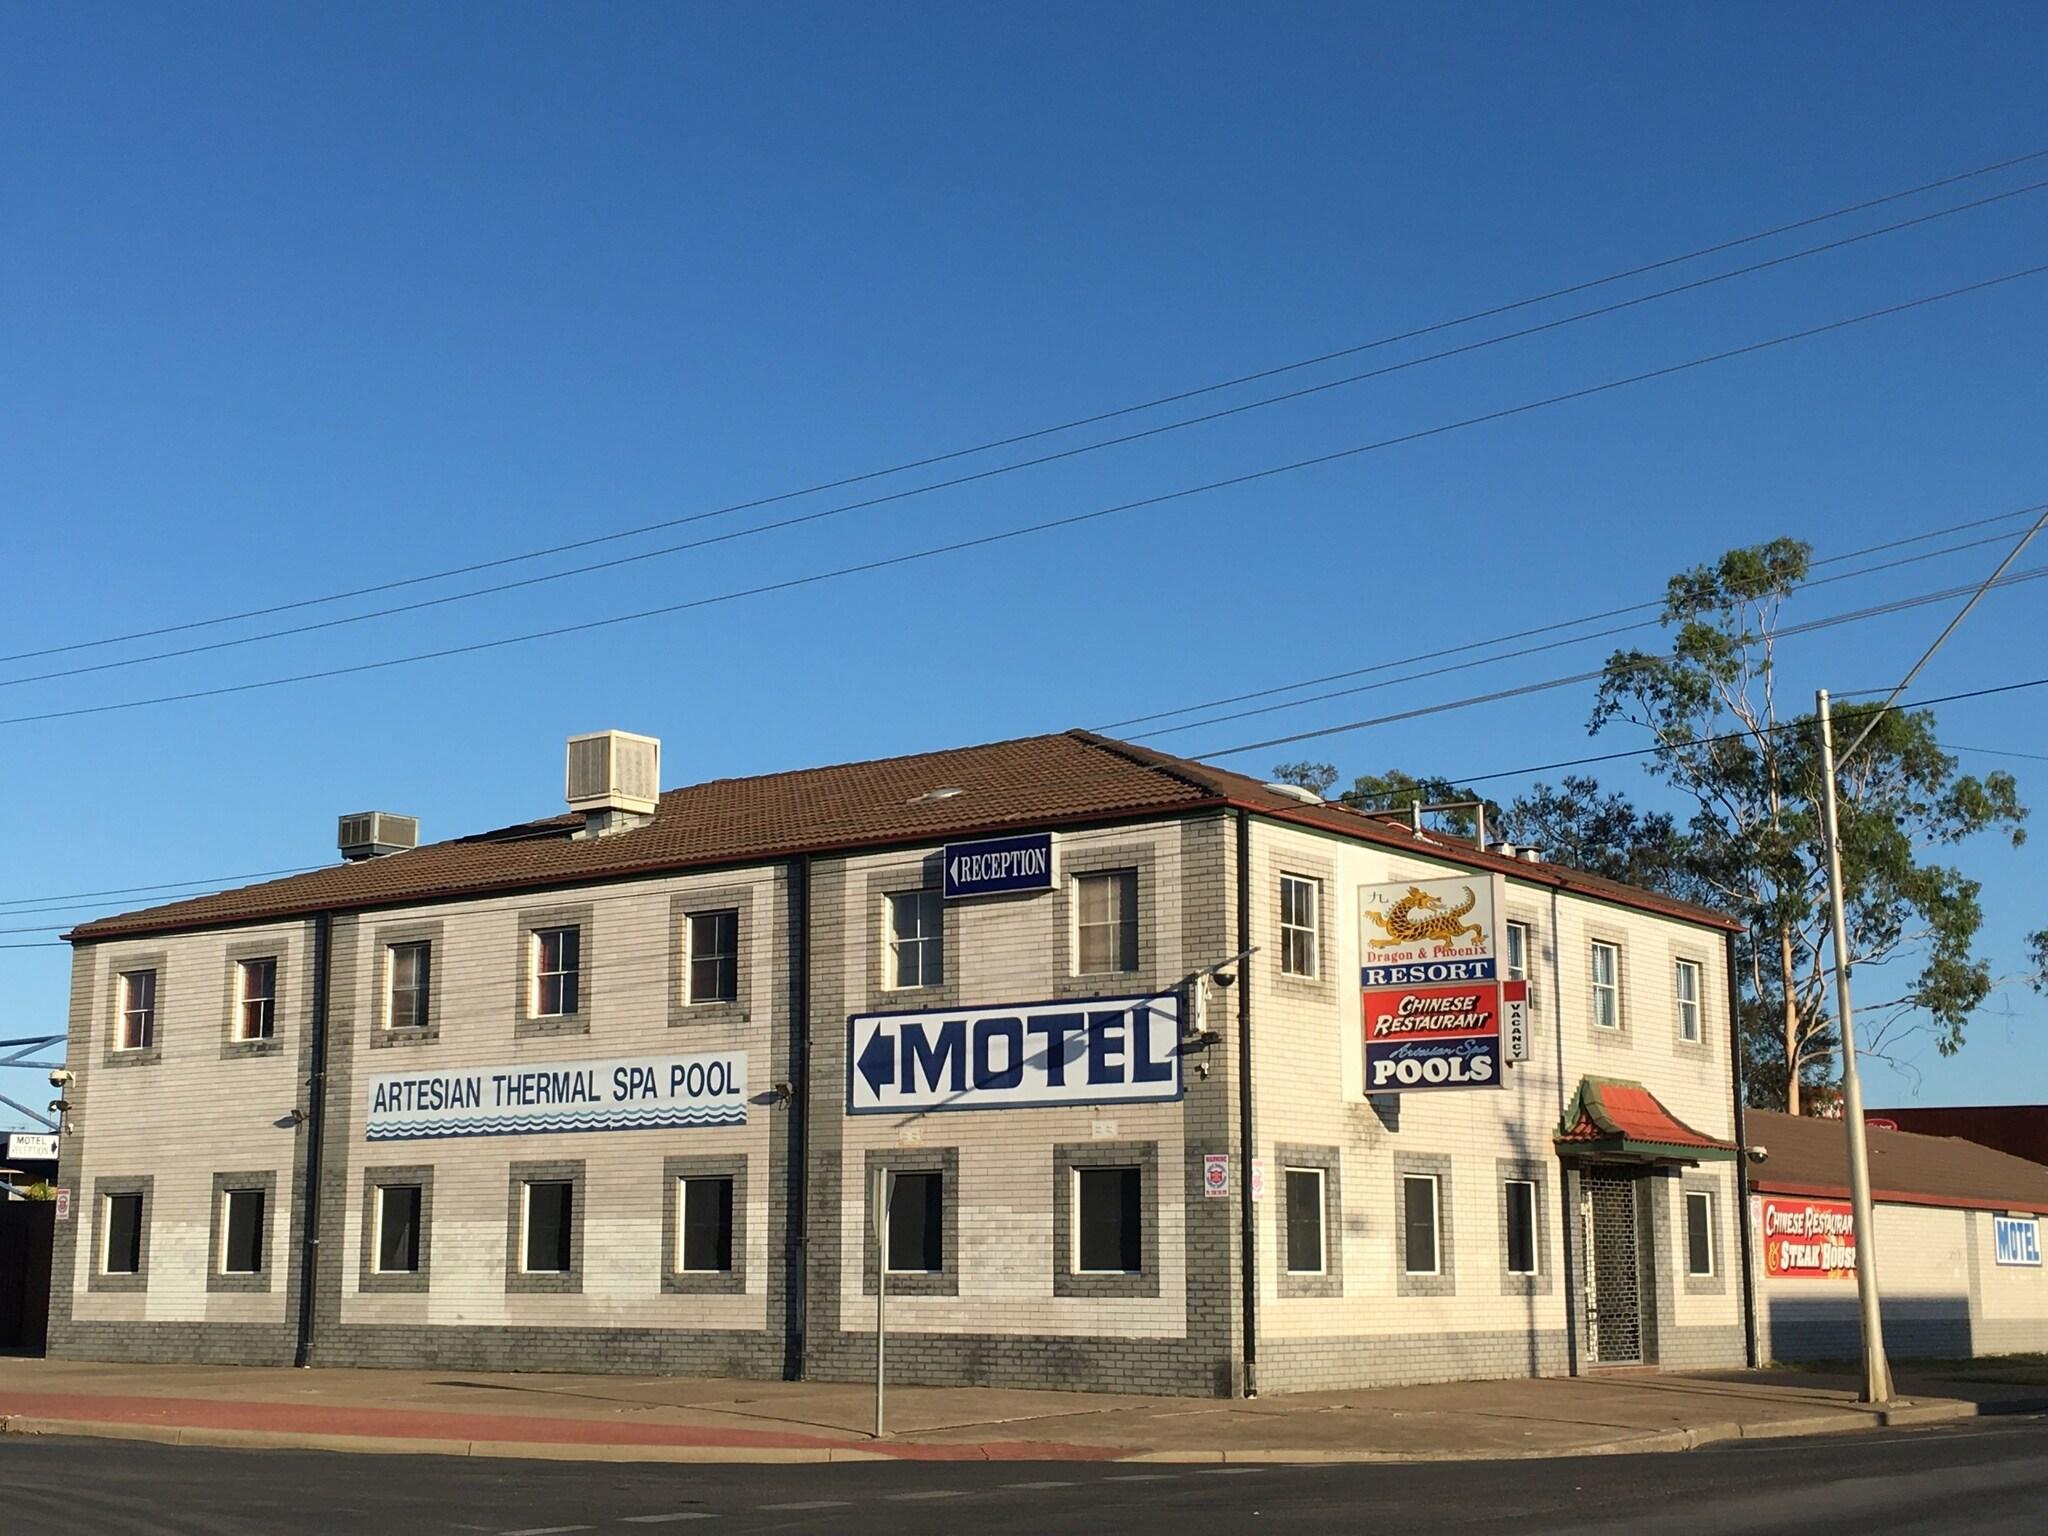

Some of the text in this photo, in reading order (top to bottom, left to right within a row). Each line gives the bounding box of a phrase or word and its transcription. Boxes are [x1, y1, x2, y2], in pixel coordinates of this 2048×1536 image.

[960, 847, 1047, 882] RECEPTION
[1367, 944, 1487, 963] Dragon & Phoenix
[1366, 961, 1488, 985] RESORT
[1397, 994, 1477, 1016] CHINESE
[1373, 1013, 1489, 1036] RESTAURANT
[1511, 1003, 1522, 1058] VACANCY
[900, 1007, 1173, 1094] MOTEL
[1389, 1039, 1490, 1060] Artesian Spa
[1373, 1055, 1493, 1085] POOLS
[373, 1061, 740, 1113] ARTESIAN THERMAL SPA POOL
[16, 1136, 47, 1145] MOTEL
[1766, 1204, 1854, 1238] CHINESE RESTAURAN
[1768, 1241, 1779, 1271] &
[1781, 1240, 1821, 1270] STEAK
[1996, 1220, 2040, 1261] MOTEL
